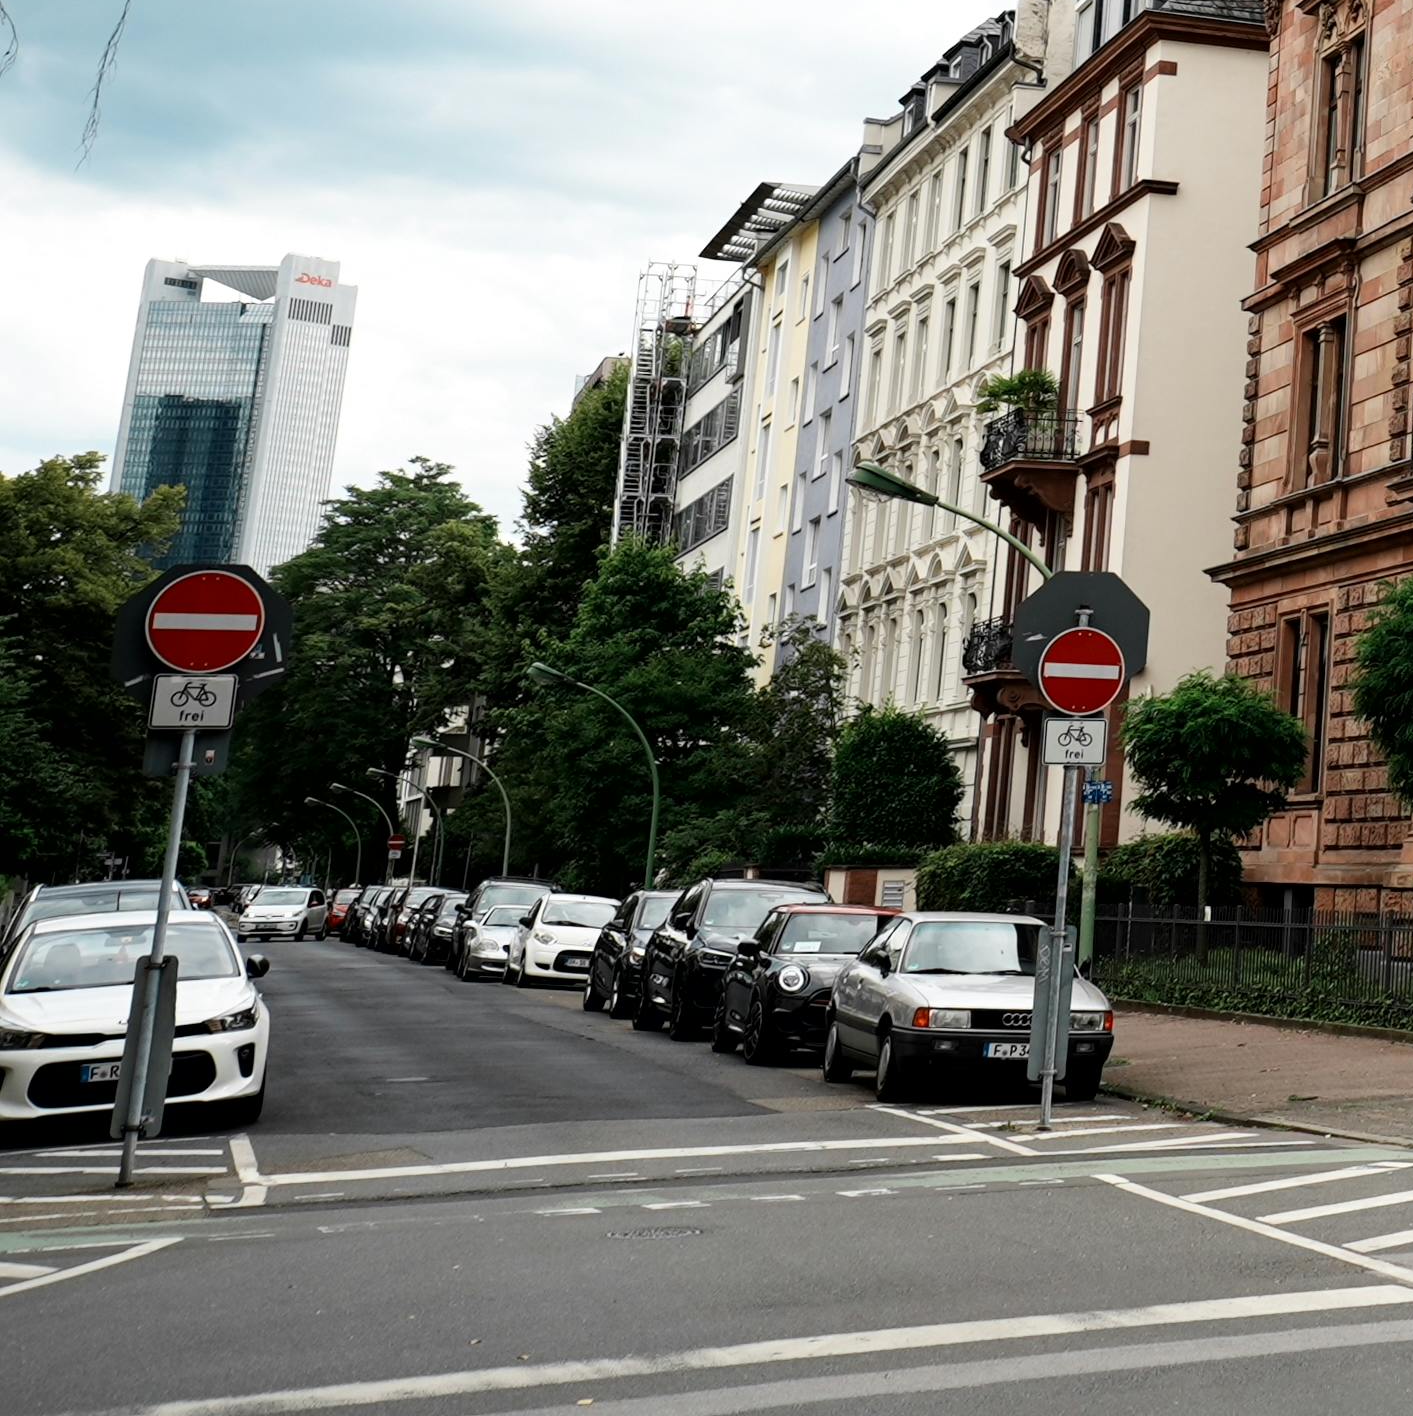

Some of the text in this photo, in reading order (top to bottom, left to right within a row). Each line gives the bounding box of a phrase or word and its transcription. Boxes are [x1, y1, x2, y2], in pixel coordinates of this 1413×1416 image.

[294, 272, 333, 288] Deka
[178, 710, 205, 722] frei
[1065, 749, 1085, 759] frei
[993, 1044, 1003, 1057] F
[1009, 1044, 1018, 1057] P
[90, 1066, 100, 1080] F
